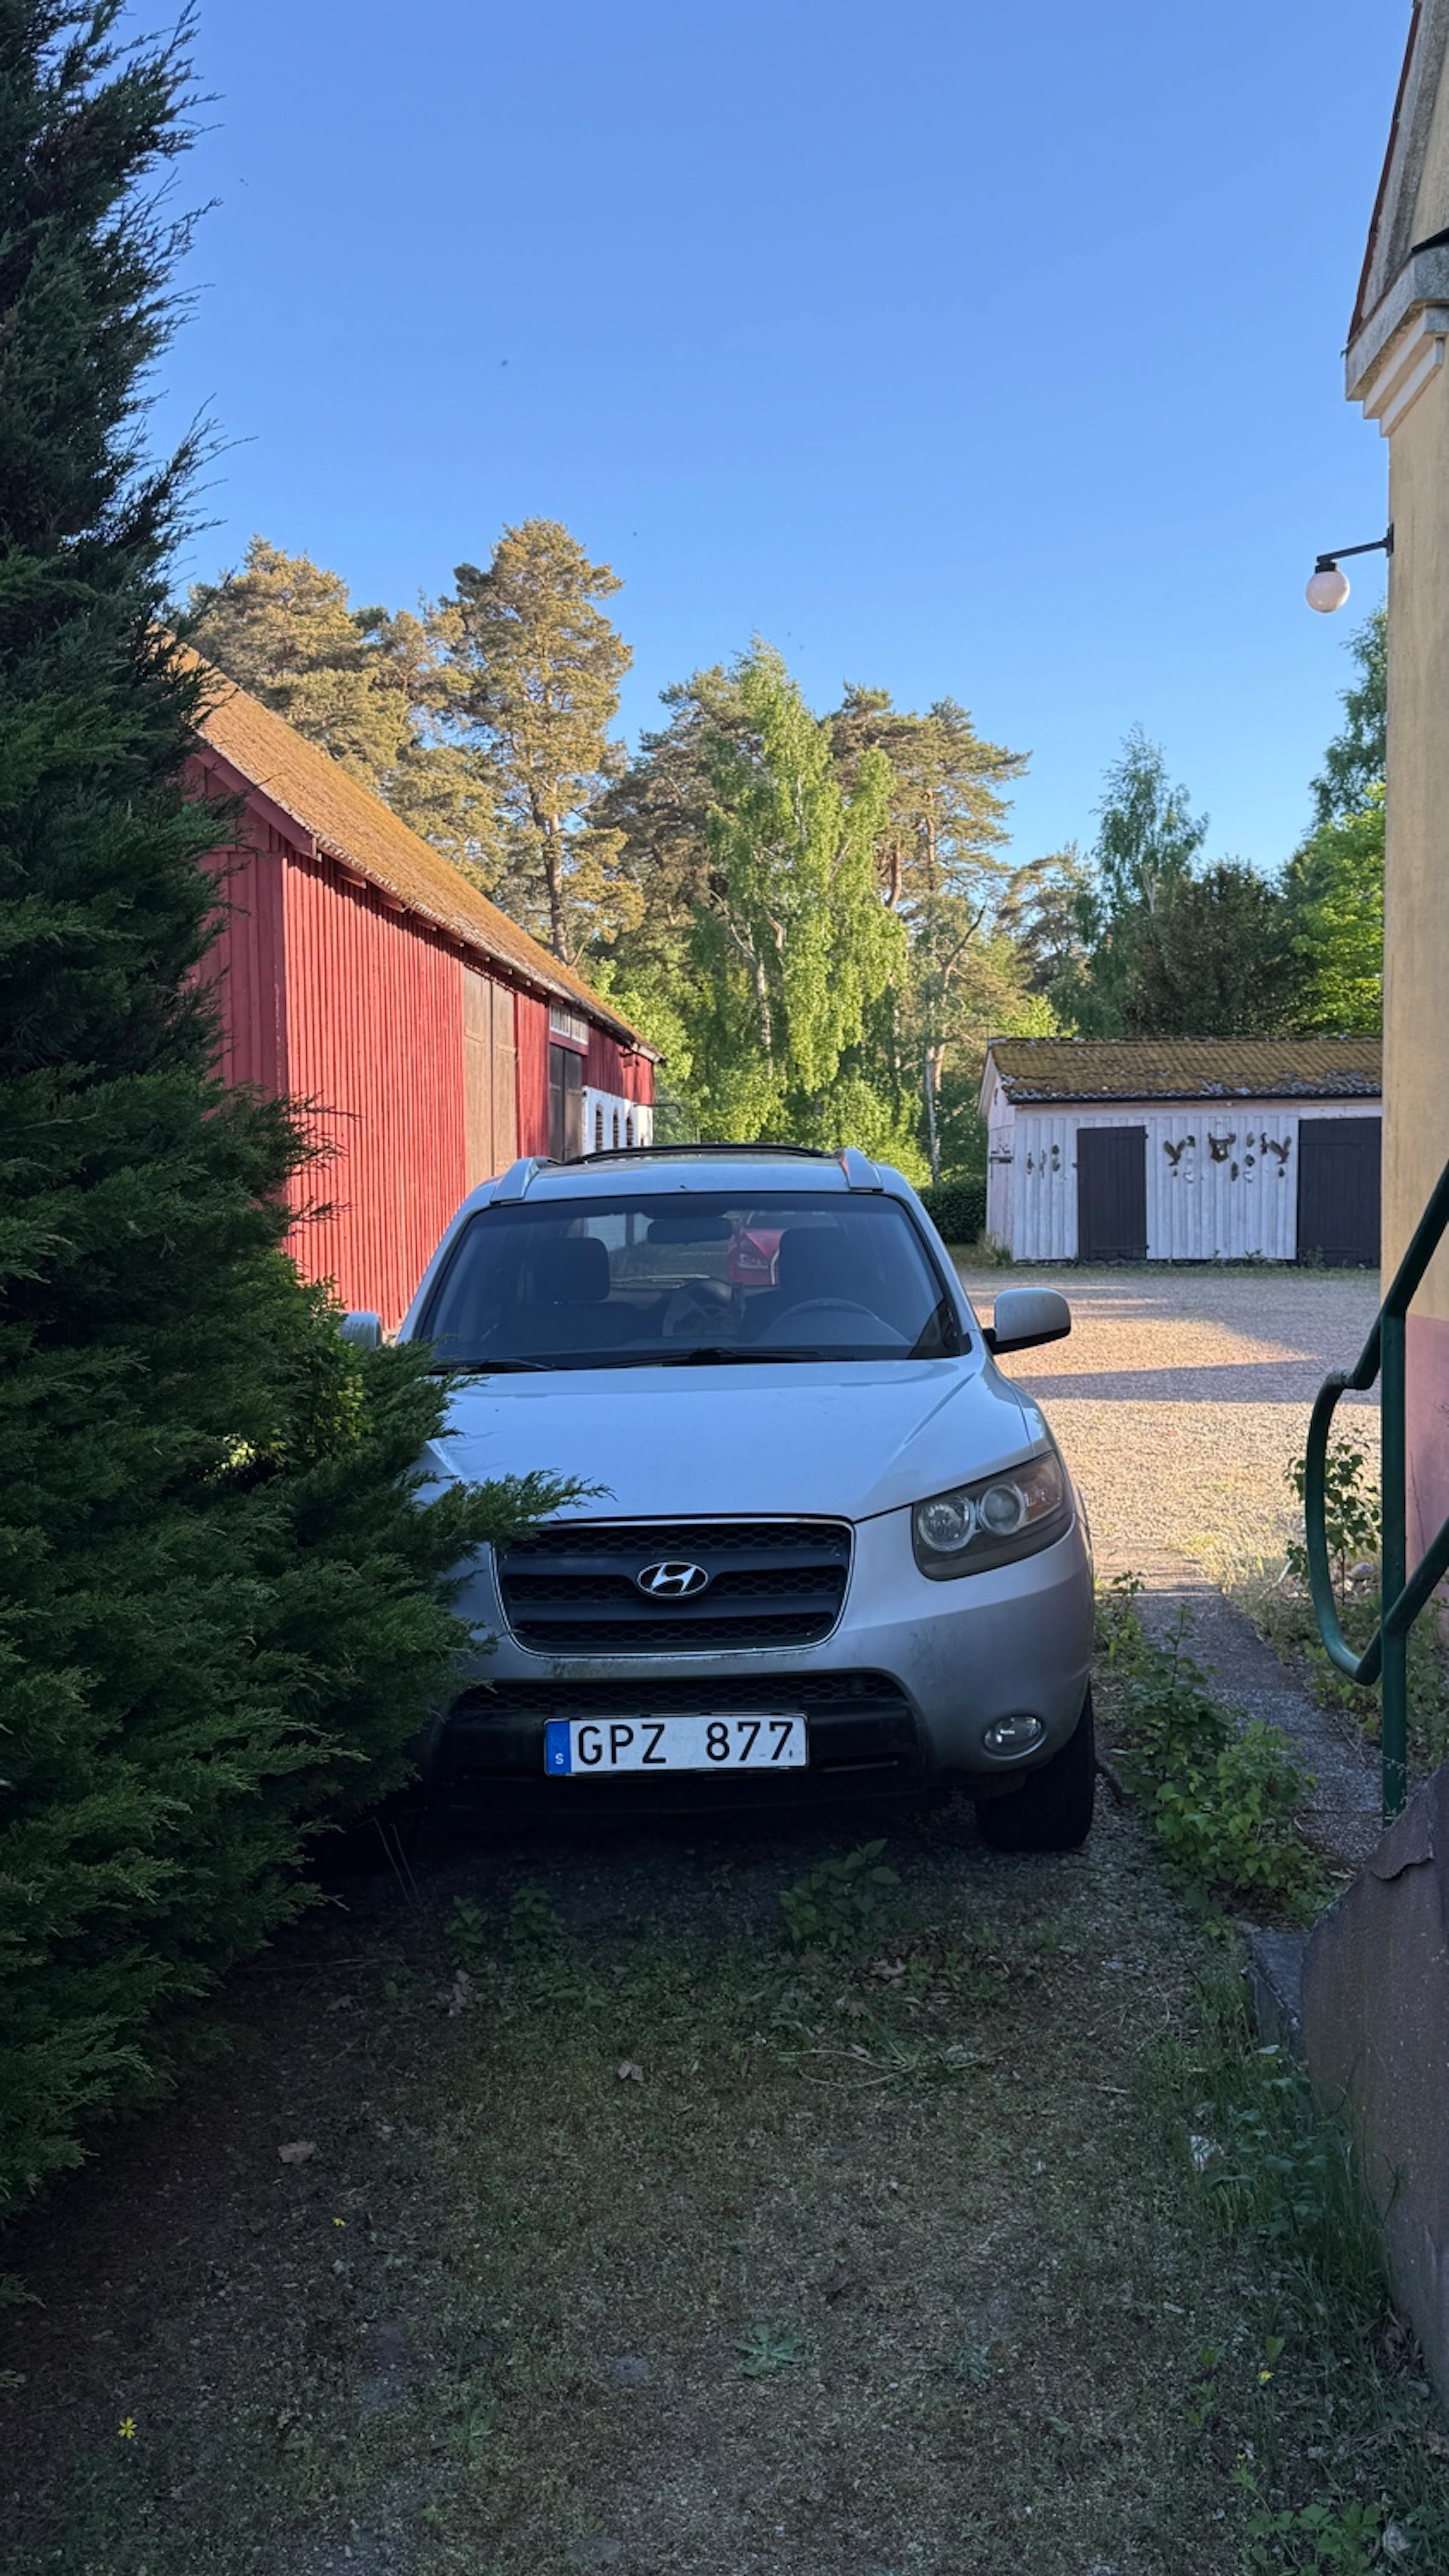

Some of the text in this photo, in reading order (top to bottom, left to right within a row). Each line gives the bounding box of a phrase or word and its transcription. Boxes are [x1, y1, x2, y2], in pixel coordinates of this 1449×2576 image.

[578, 1721, 793, 1766] GPZ 877
[555, 1752, 564, 1765] S
